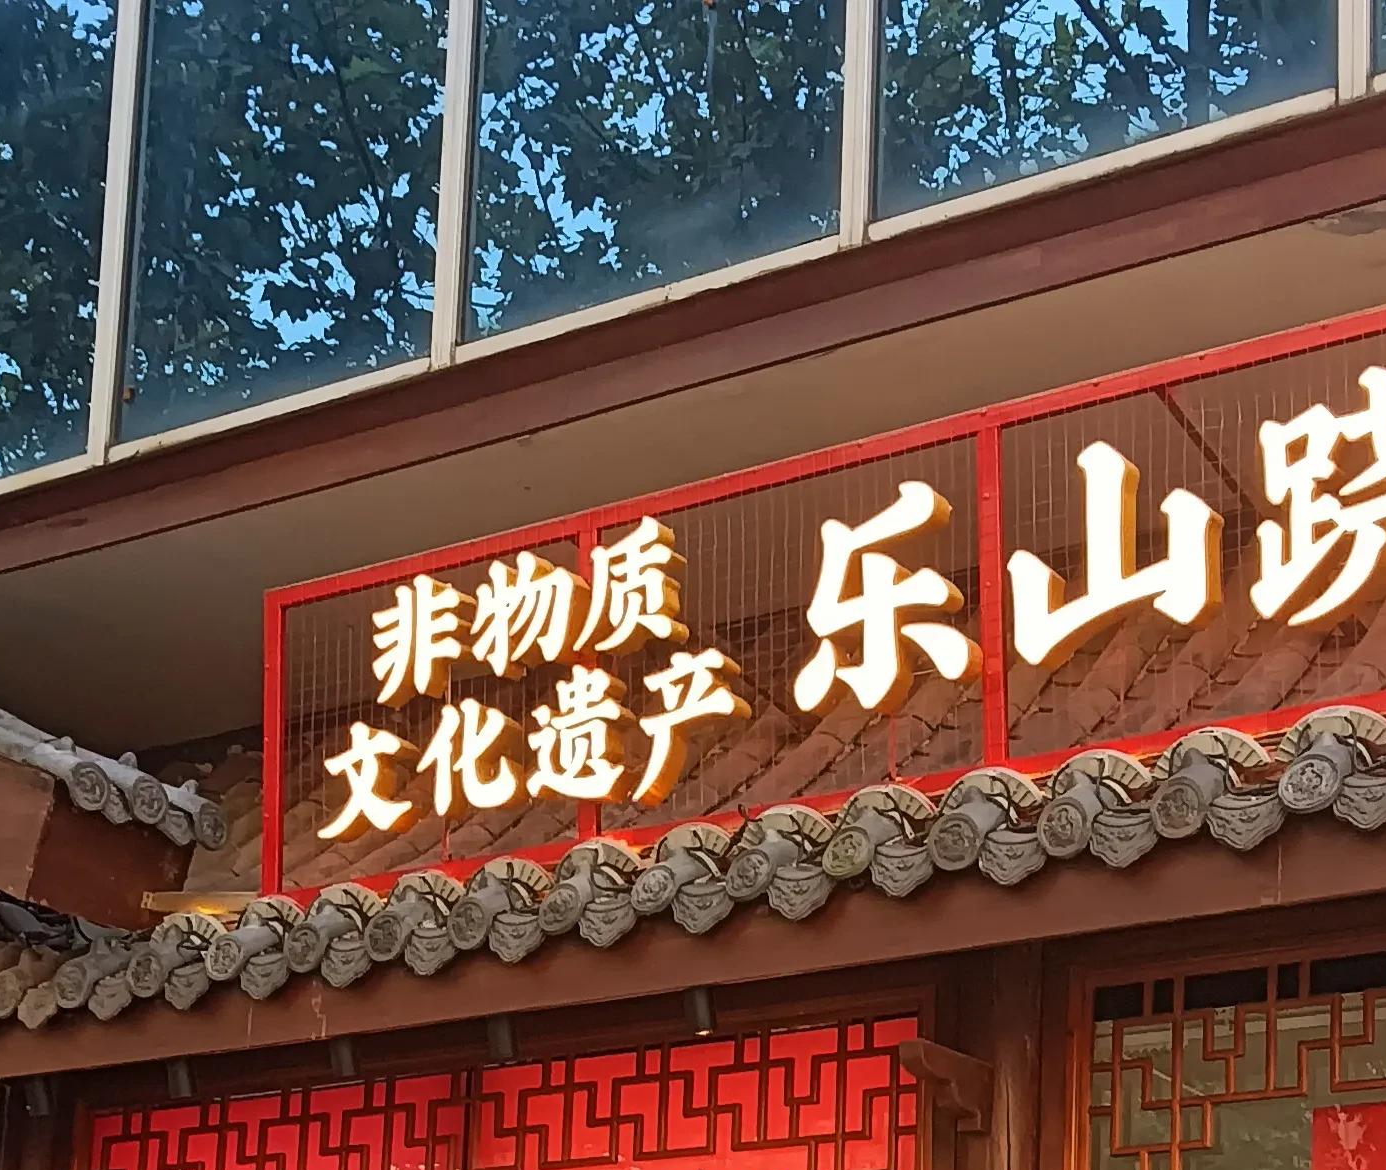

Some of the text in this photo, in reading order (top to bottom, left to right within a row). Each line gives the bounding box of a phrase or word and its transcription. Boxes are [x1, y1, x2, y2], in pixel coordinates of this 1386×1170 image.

[372, 515, 685, 704] 非物质
[317, 646, 748, 840] 文化遗产
